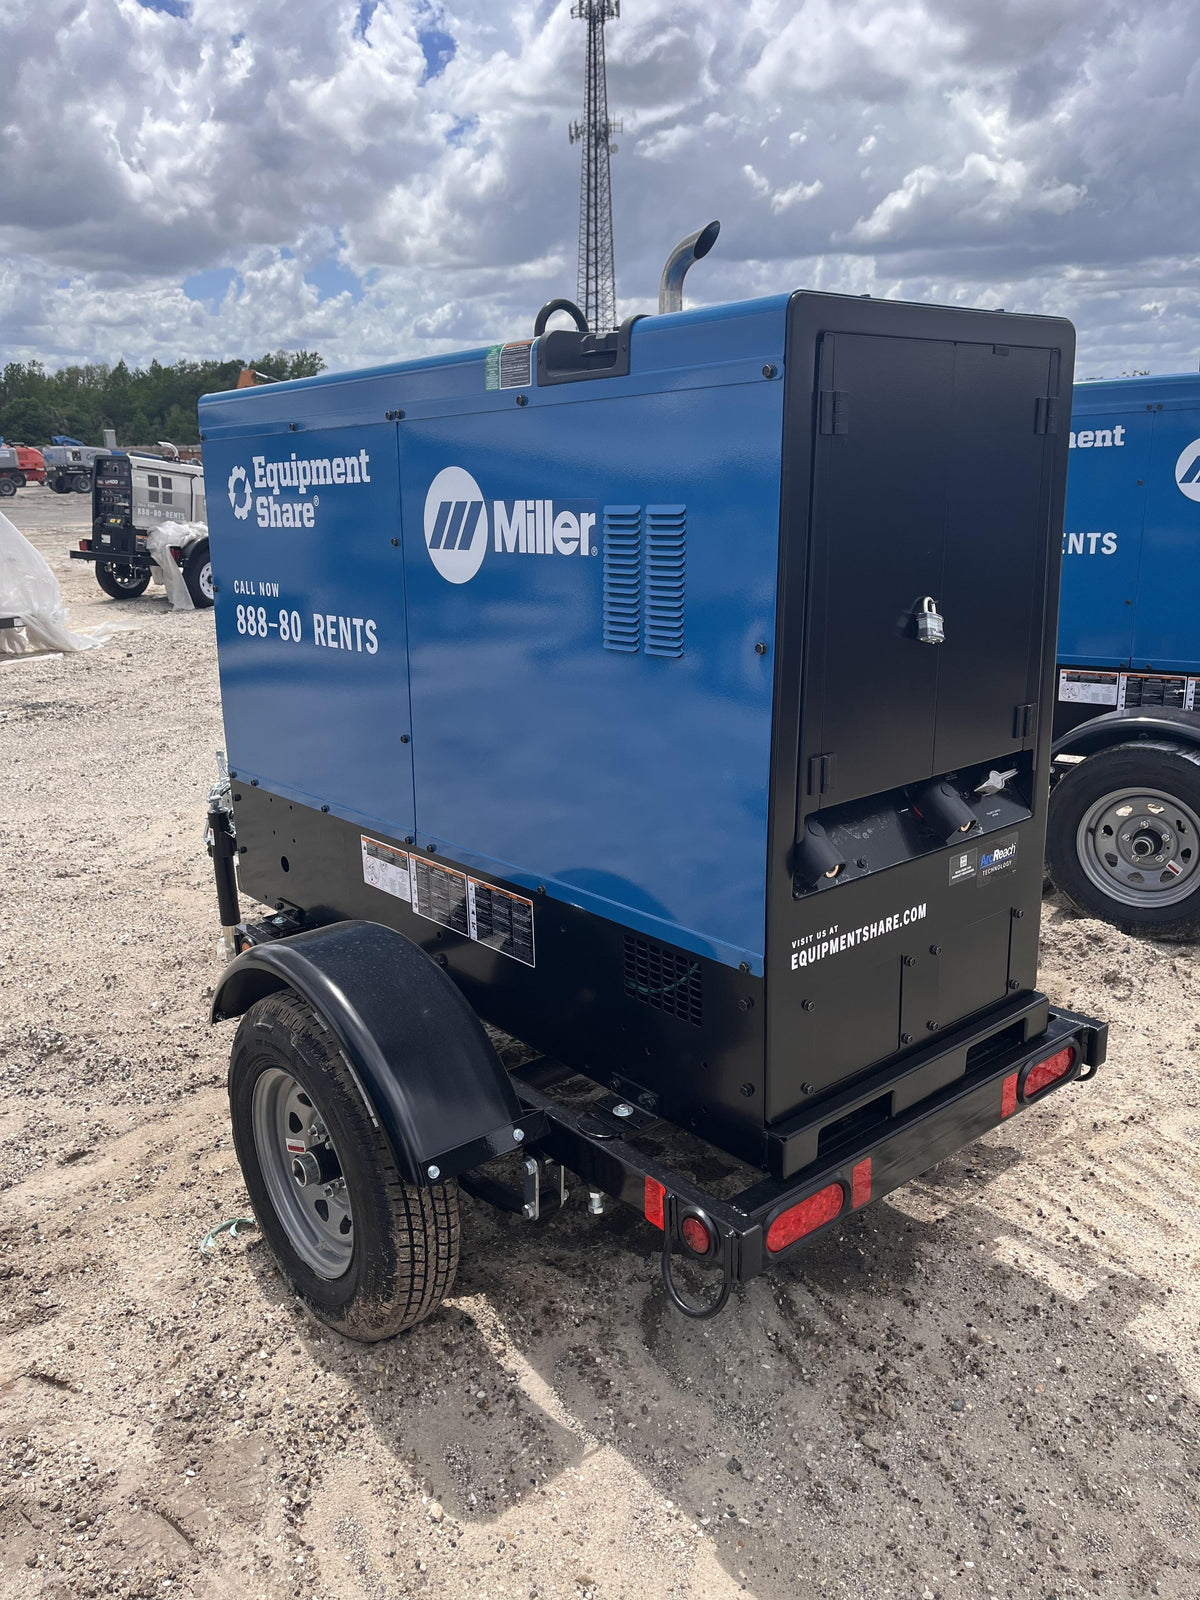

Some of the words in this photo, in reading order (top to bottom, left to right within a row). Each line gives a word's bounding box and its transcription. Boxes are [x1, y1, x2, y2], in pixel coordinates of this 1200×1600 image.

[252, 449, 371, 495] Equipment
[233, 579, 256, 596] CALL
[259, 581, 279, 598] NOW
[236, 604, 302, 643] 888-80
[313, 613, 379, 655] RENTS
[981, 842, 1016, 867] ArcReach
[982, 860, 1012, 877] TECHNOLOGY
[791, 934, 814, 949] VISIT
[816, 929, 827, 940] US
[829, 924, 839, 935] AT
[791, 902, 927, 971] EQUIPMENTSHARE.COM
